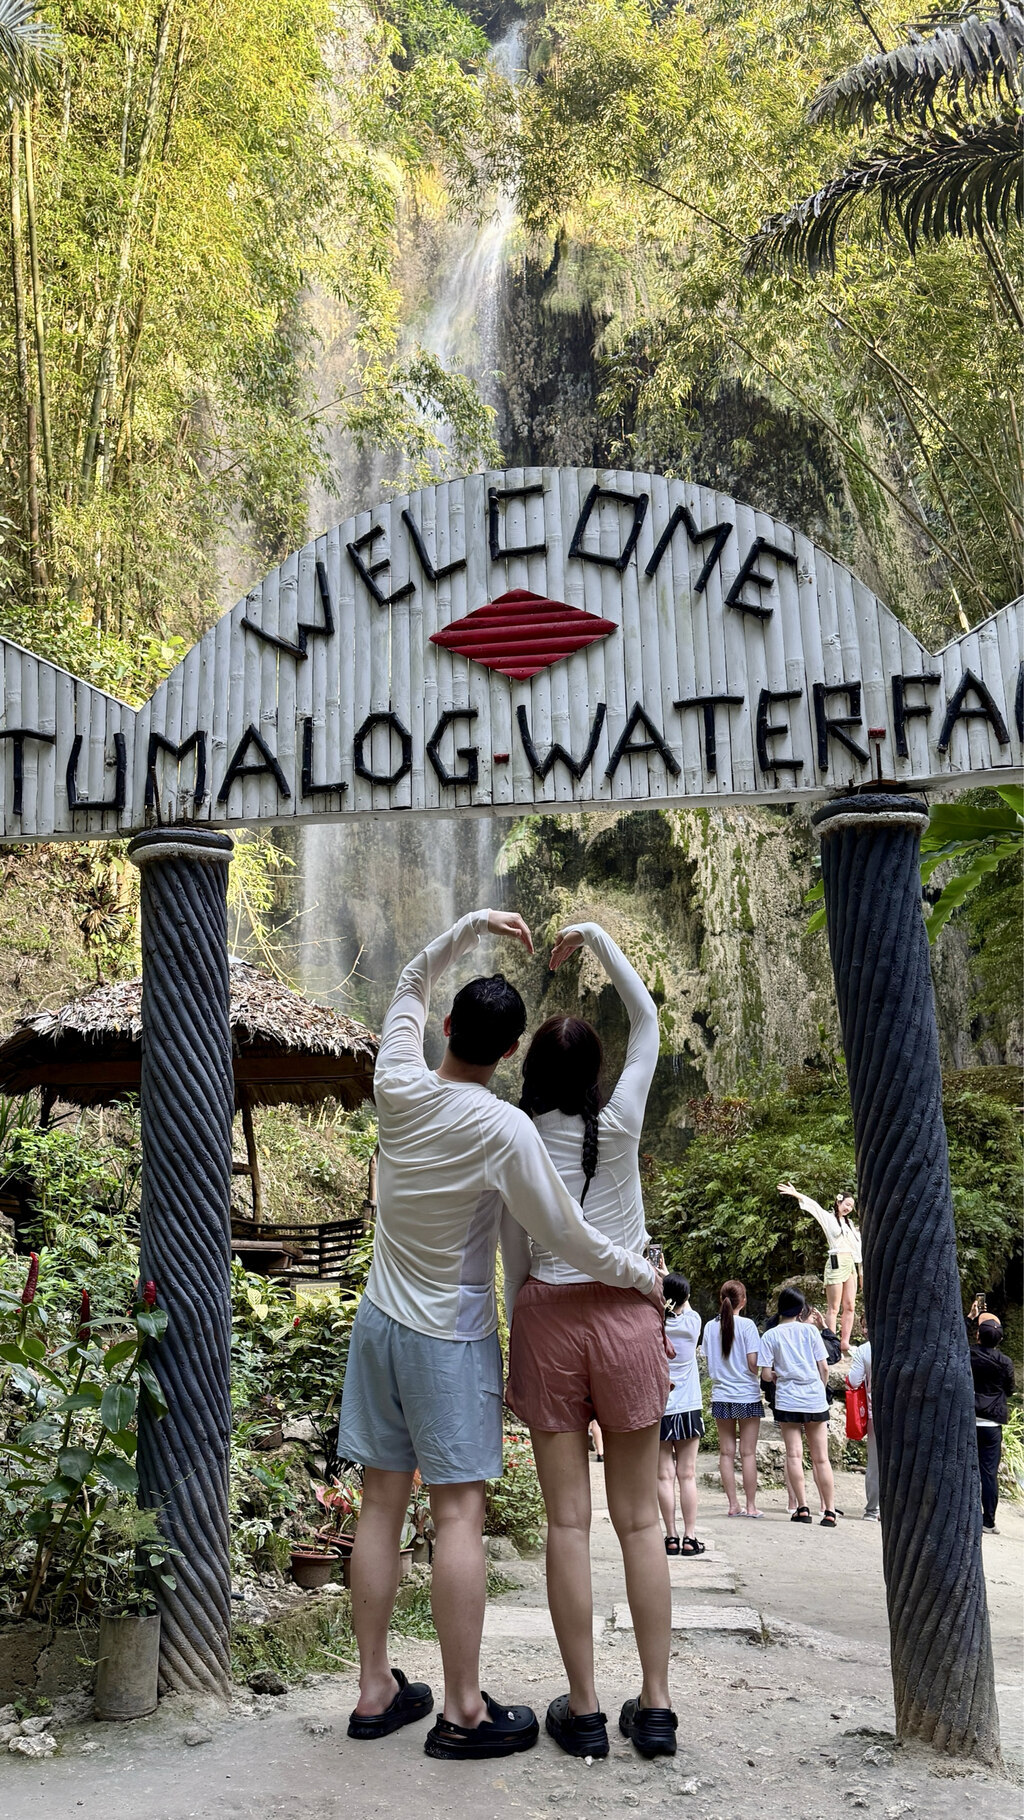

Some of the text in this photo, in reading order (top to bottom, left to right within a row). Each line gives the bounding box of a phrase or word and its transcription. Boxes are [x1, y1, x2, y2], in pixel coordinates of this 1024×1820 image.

[241, 484, 798, 660] WELCOME
[0, 660, 1024, 815] TUMALOG WATER FA
